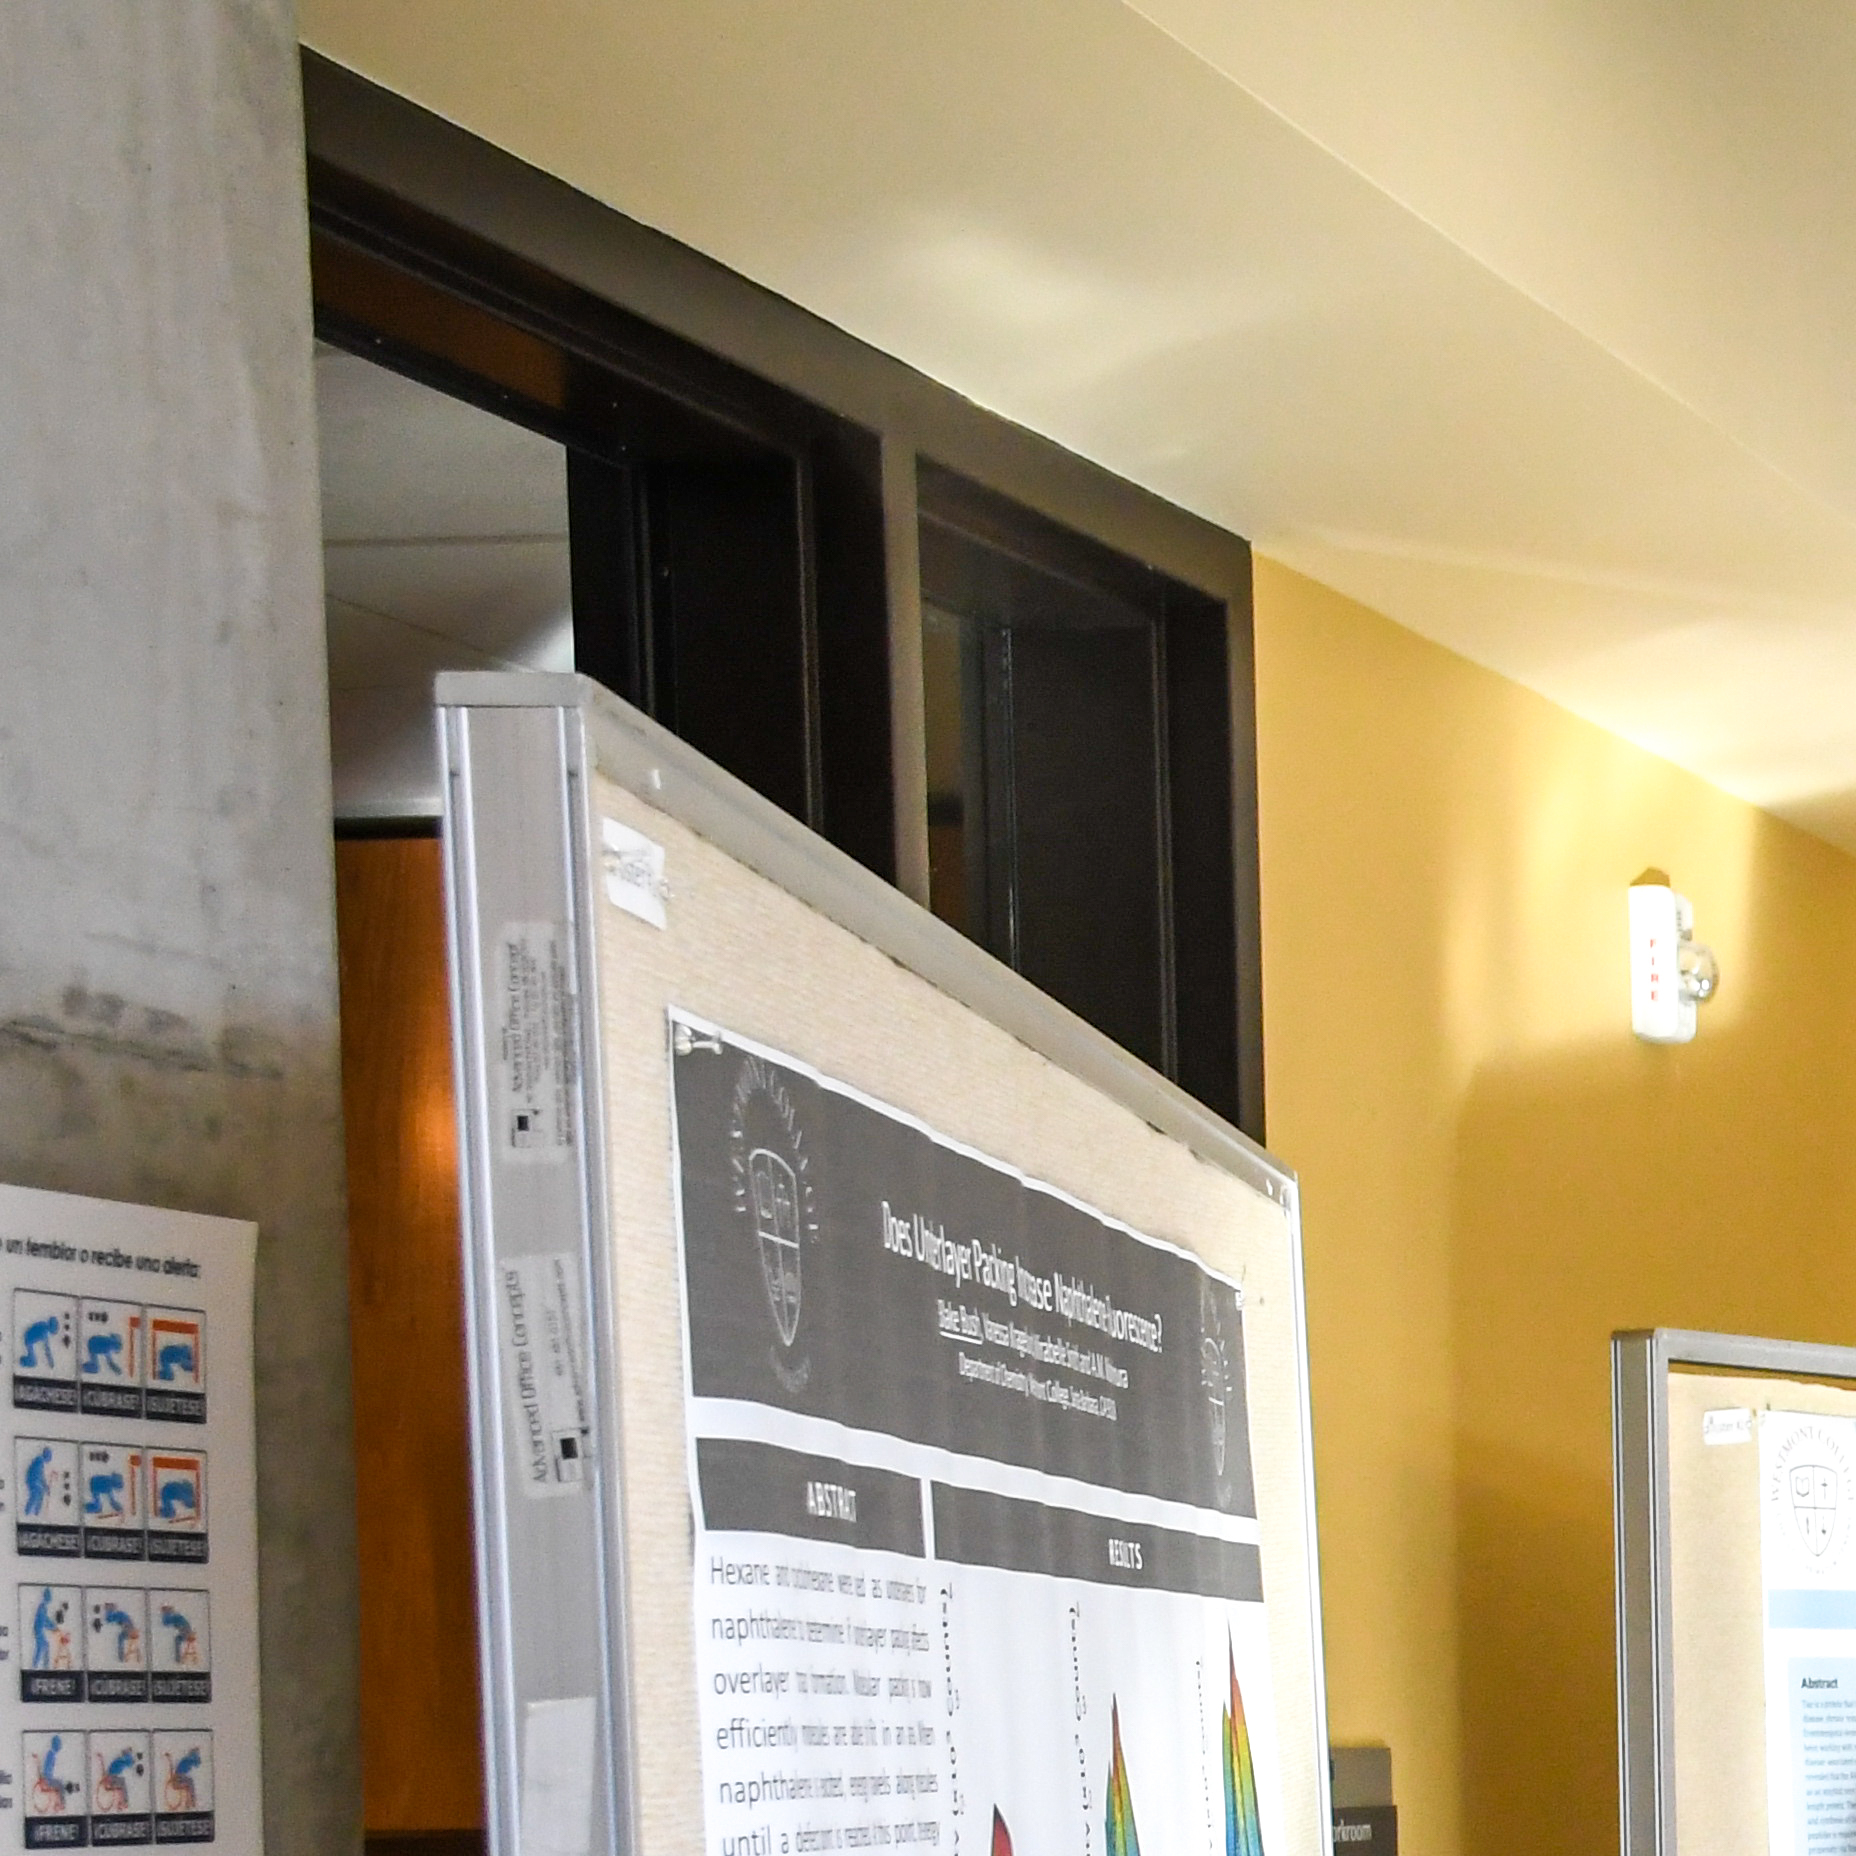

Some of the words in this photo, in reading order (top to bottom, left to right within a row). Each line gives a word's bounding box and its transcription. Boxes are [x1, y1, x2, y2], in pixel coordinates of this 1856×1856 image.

[882, 1200, 912, 1258] Does
[26, 1237, 77, 1261] temblor
[80, 1248, 89, 1263] o
[91, 1247, 133, 1269] recibe
[136, 1256, 160, 1274] una
[710, 1556, 769, 1585] Hexane
[1801, 1677, 1839, 1690] Abstract
[780, 1832, 789, 1854] a
